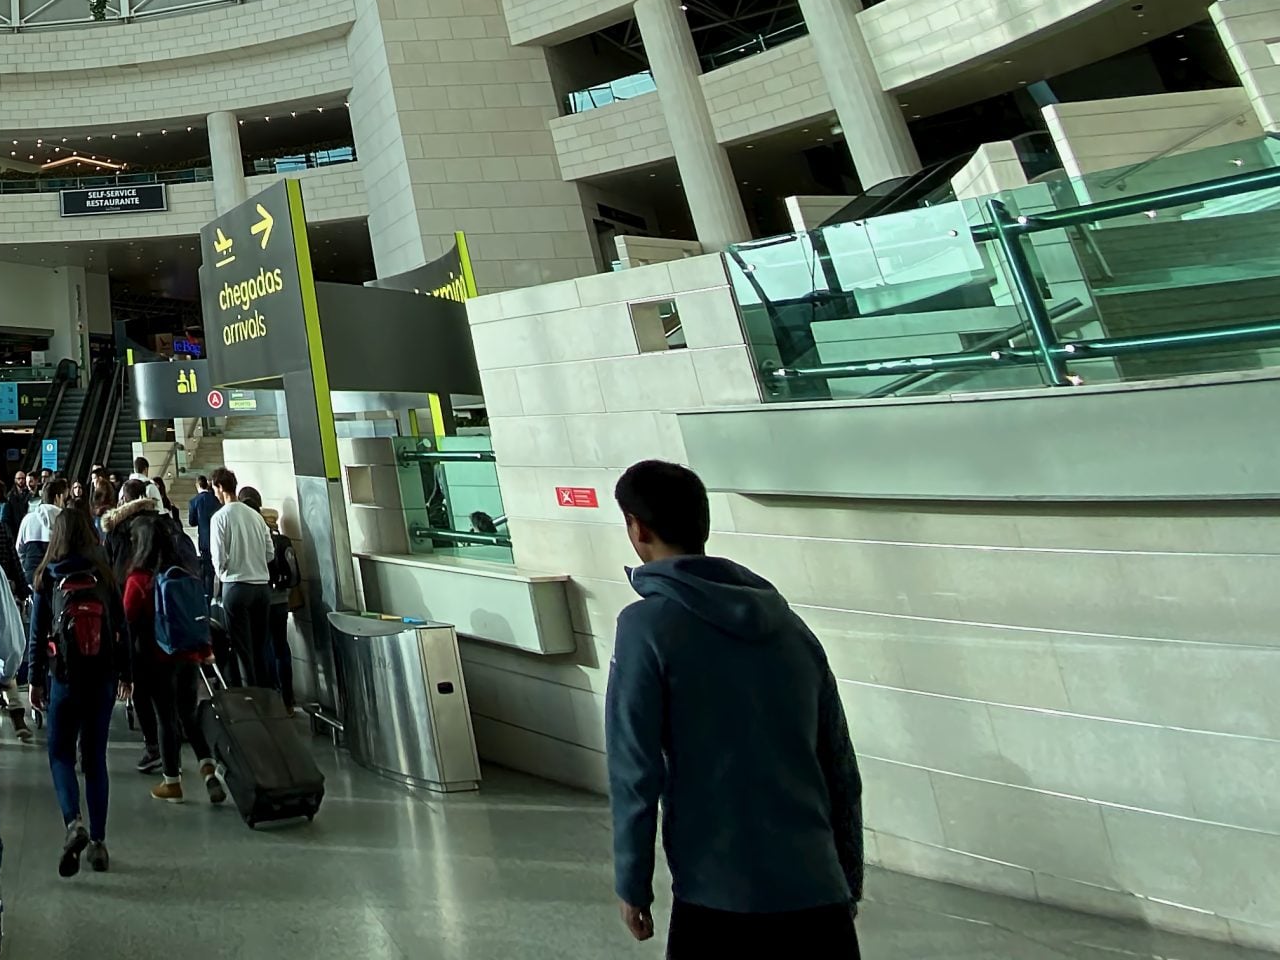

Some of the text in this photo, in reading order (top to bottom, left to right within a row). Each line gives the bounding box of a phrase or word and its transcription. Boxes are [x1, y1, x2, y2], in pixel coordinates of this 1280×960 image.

[86, 197, 140, 207] RESTAURANTE
[88, 189, 137, 199] SELF-SERVICE
[220, 267, 283, 310] chegadas
[223, 310, 267, 345] arrivals
